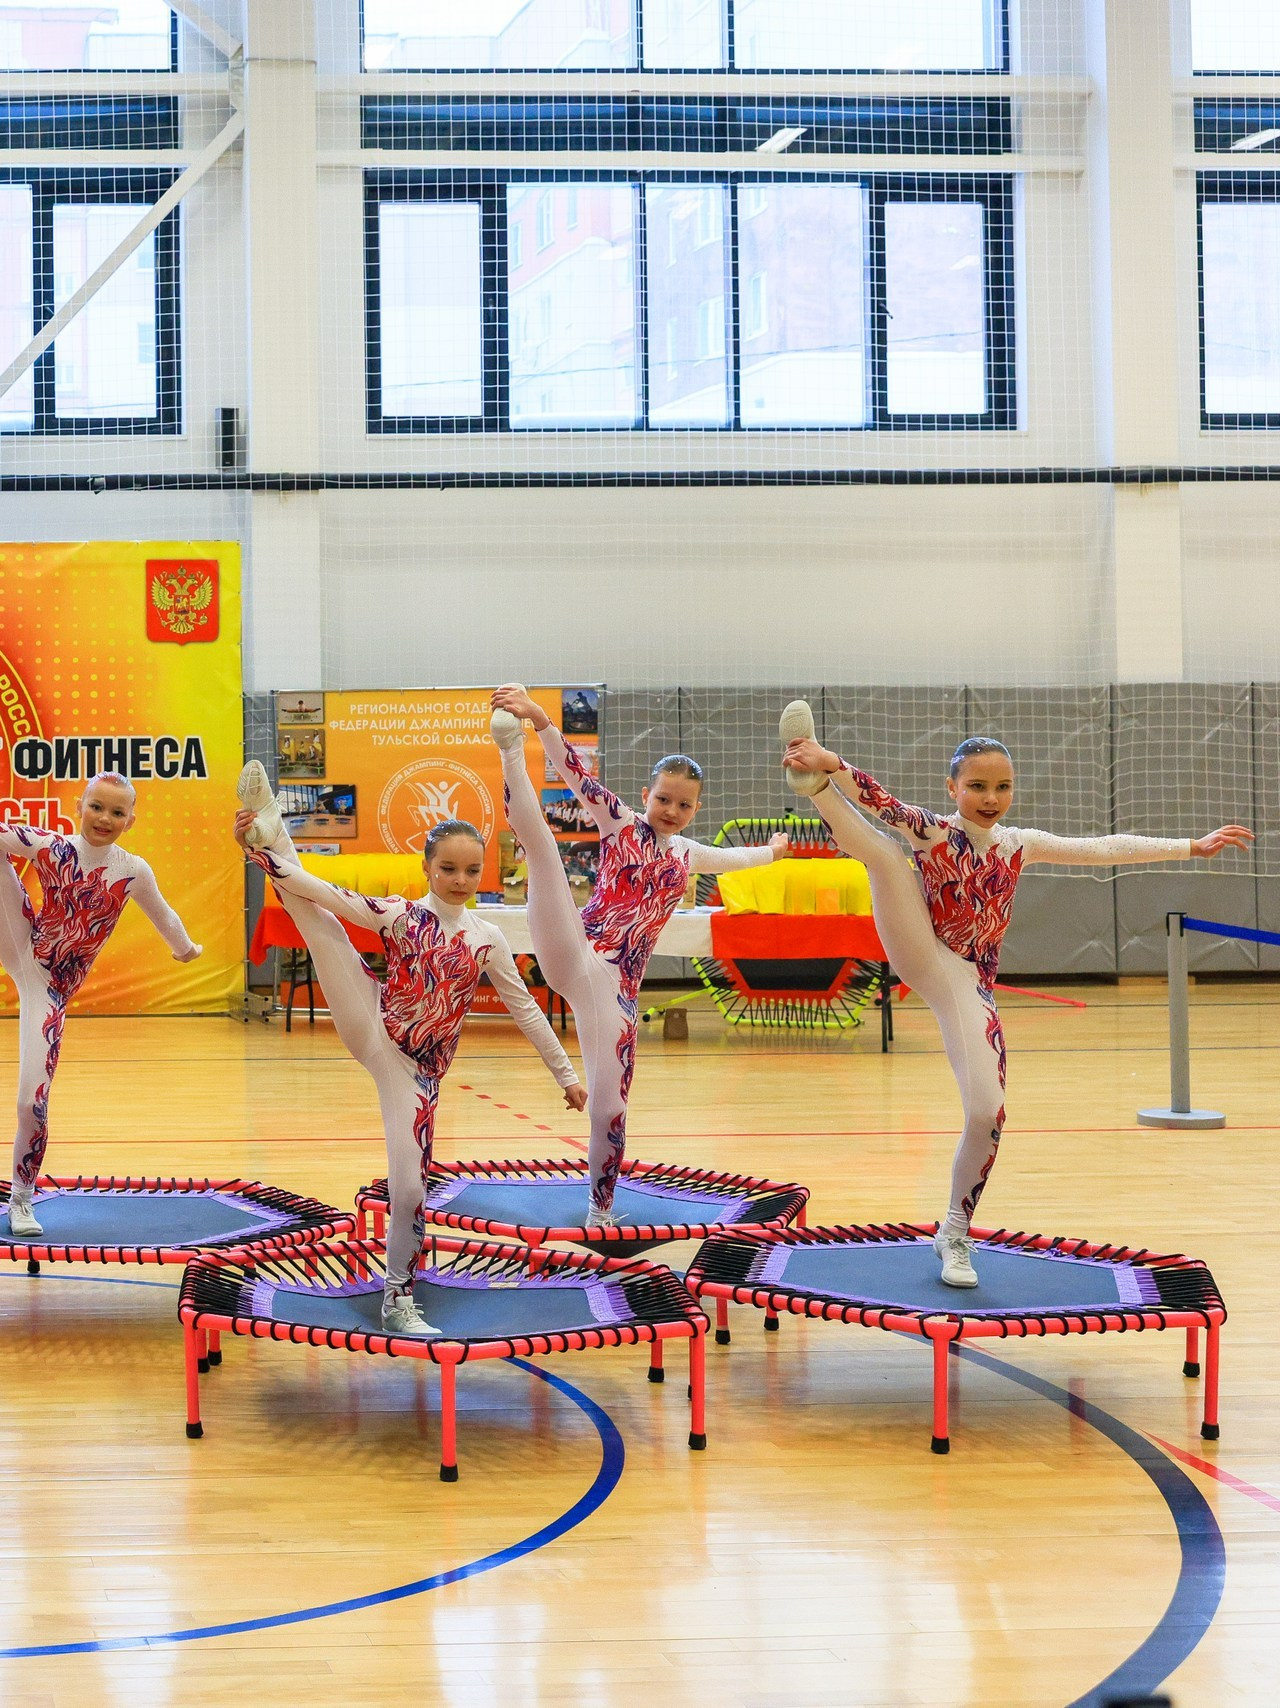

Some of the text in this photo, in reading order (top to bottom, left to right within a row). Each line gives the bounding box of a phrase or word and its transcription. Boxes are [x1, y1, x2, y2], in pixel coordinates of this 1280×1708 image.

[350, 702, 492, 715] РЕГИОНАЛЬНОЕ ОТДЕ
[329, 717, 486, 731] ФЕДЕРАЦИИ ДЖАМПИНГ
[372, 731, 496, 746] ТУЛЬСКОЙ ОБЛАС
[13, 736, 208, 780] ФИТНЕСА
